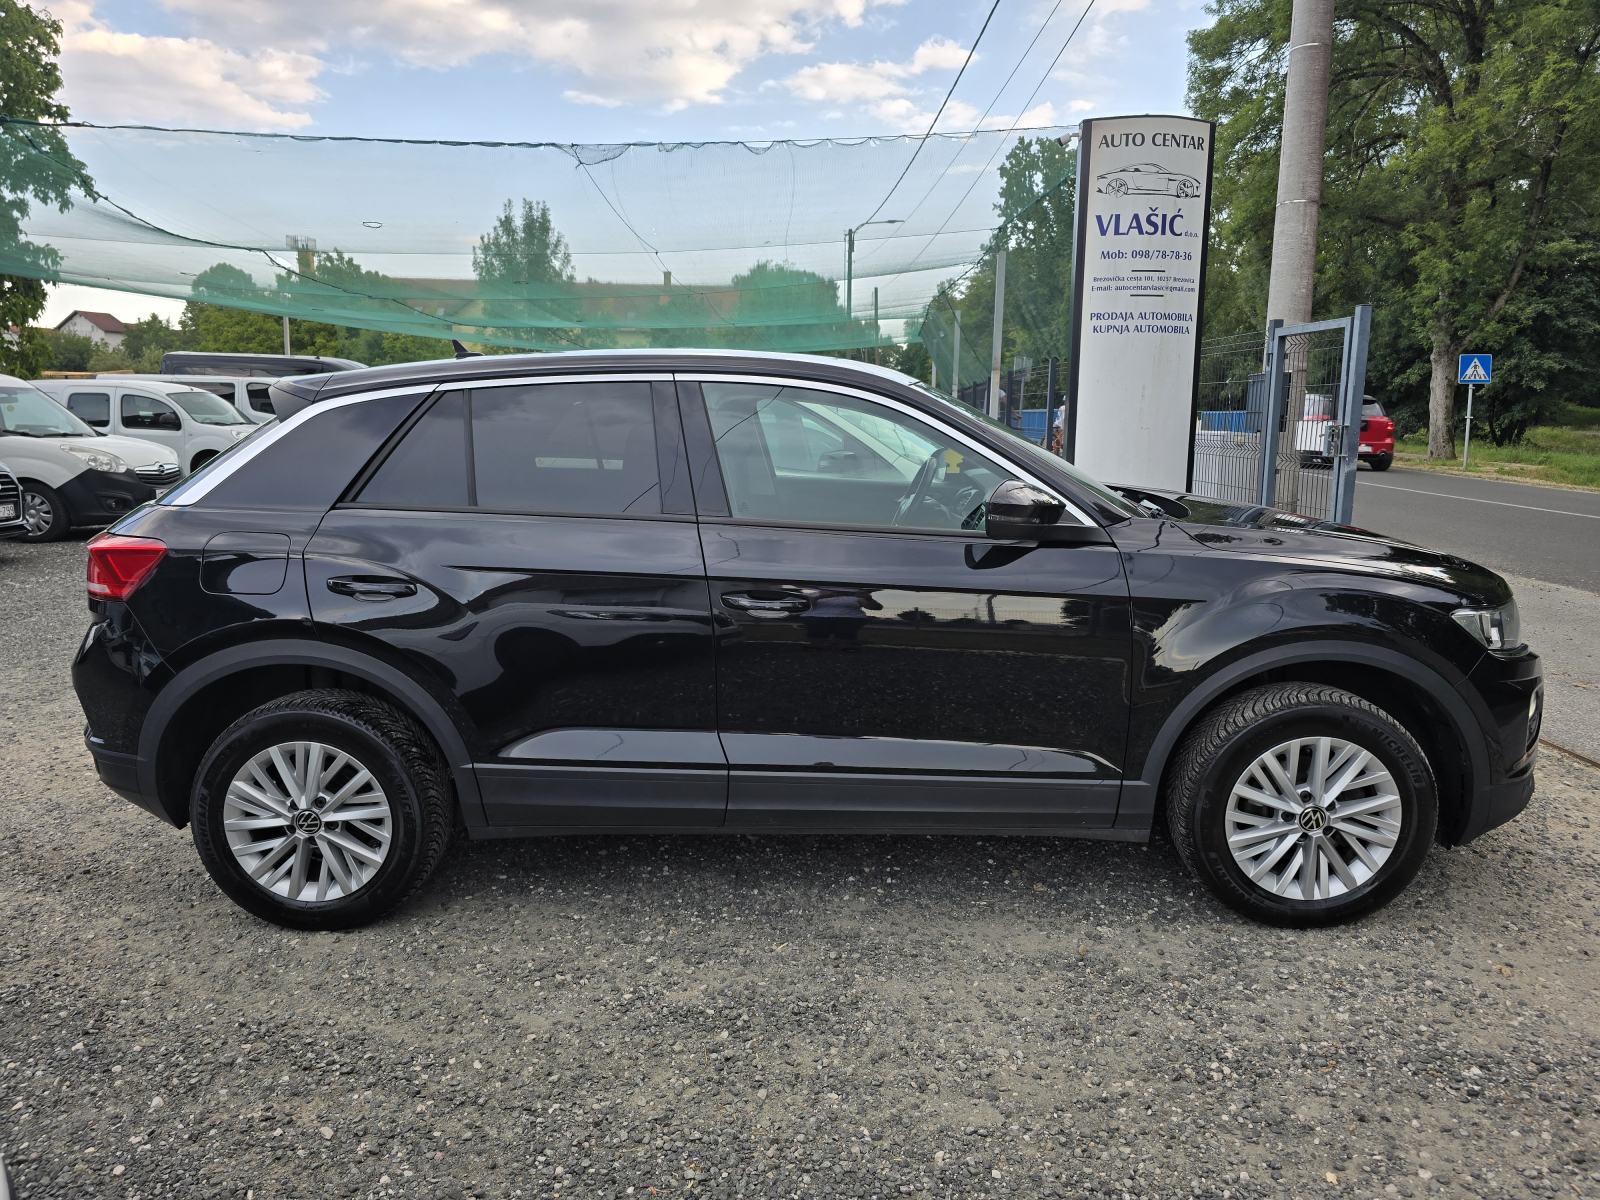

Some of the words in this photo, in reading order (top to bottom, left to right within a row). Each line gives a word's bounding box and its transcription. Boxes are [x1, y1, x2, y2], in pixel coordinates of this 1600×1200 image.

[1099, 133, 1145, 149] AUTO
[1152, 133, 1204, 151] CENTAR
[1095, 207, 1184, 237] VLAŠIĆ
[1100, 249, 1128, 260] Mob:
[1131, 249, 1192, 260] 098/78-78-36
[1091, 284, 1113, 292] E-mail:
[1090, 311, 1134, 322] PRODAJA
[1137, 311, 1193, 322] AUTOMOBILA
[1092, 324, 1130, 335] KUPNJA
[1132, 324, 1190, 335] AUTOMOBILA
[1371, 727, 1425, 786] MICHELIN
